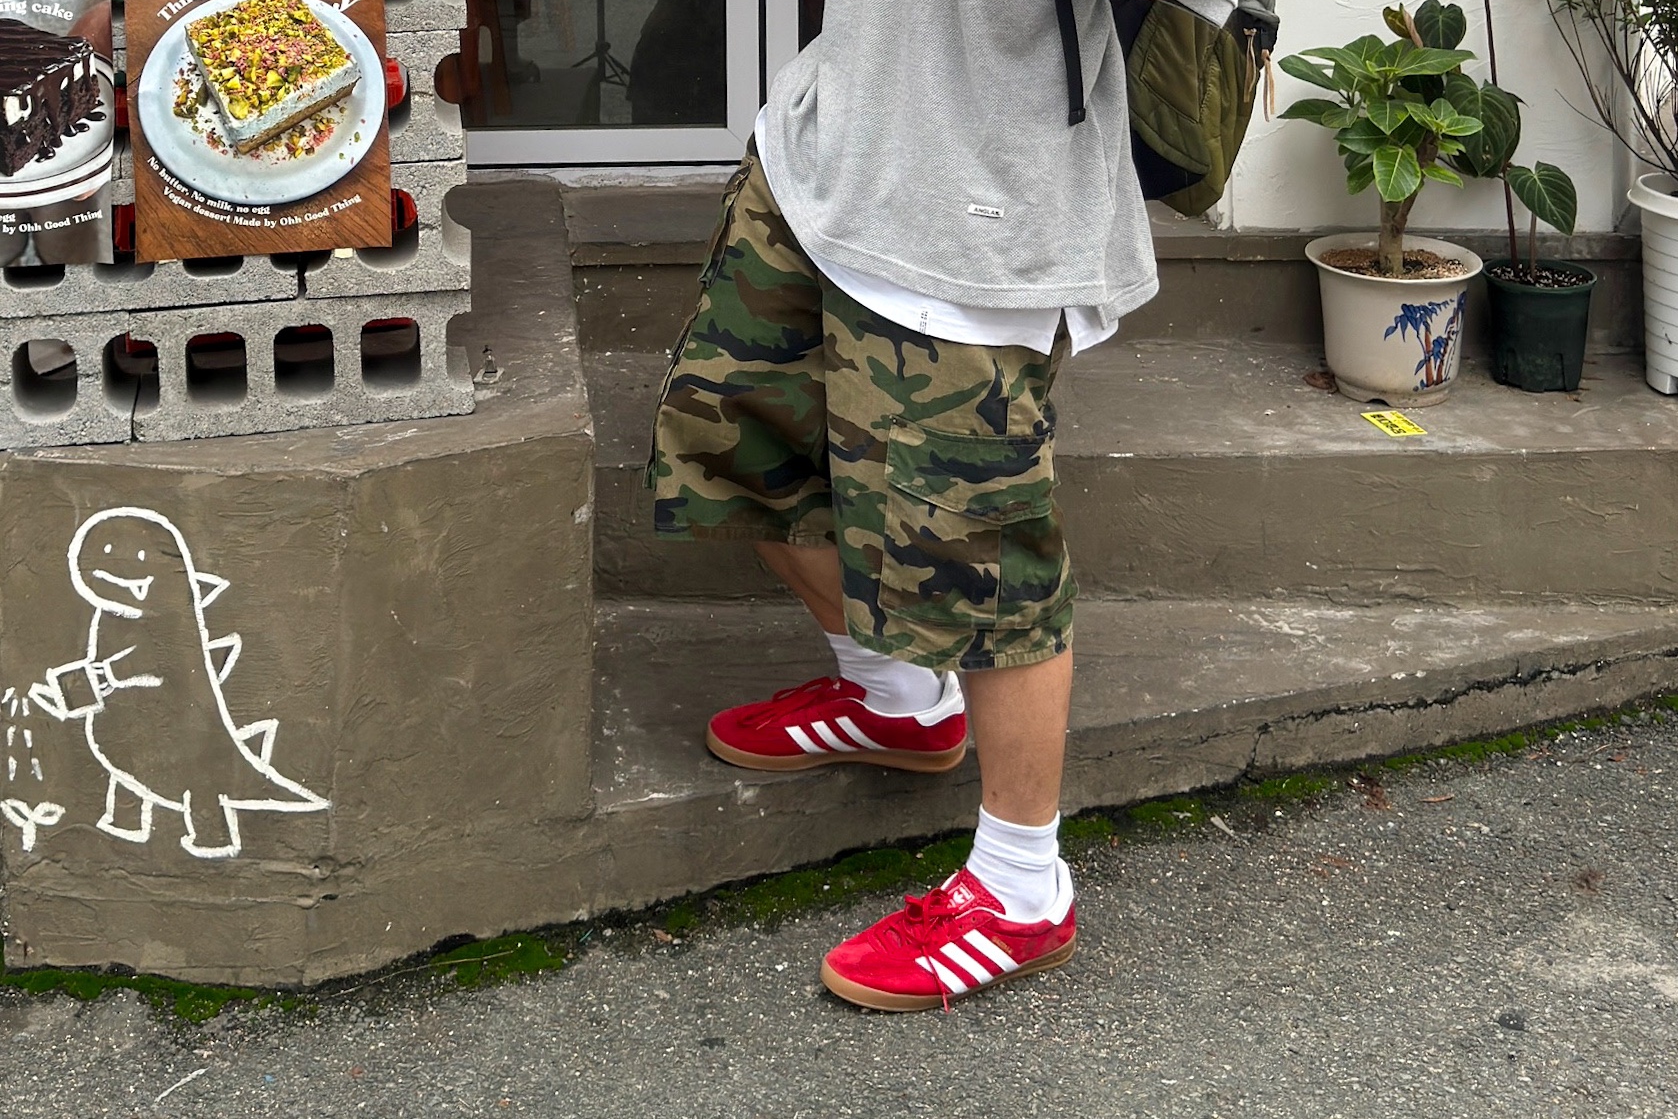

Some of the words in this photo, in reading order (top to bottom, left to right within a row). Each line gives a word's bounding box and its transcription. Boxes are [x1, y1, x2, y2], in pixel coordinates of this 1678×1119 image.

[31, 3, 74, 21] cake
[147, 156, 160, 171] No
[159, 168, 190, 196] butter,
[191, 190, 205, 203] No
[206, 200, 234, 212] milk,
[236, 205, 249, 213] no
[251, 206, 271, 215] egg
[2, 224, 16, 235] by
[19, 222, 42, 233] Ohh
[44, 217, 71, 230] Good
[72, 209, 103, 224] Thing
[163, 185, 192, 210] Vegan
[193, 204, 231, 223] dessert
[232, 216, 261, 227] Made
[264, 218, 277, 229] by
[280, 216, 302, 226] Ohh
[304, 207, 330, 222] Good
[330, 194, 362, 213] Thing
